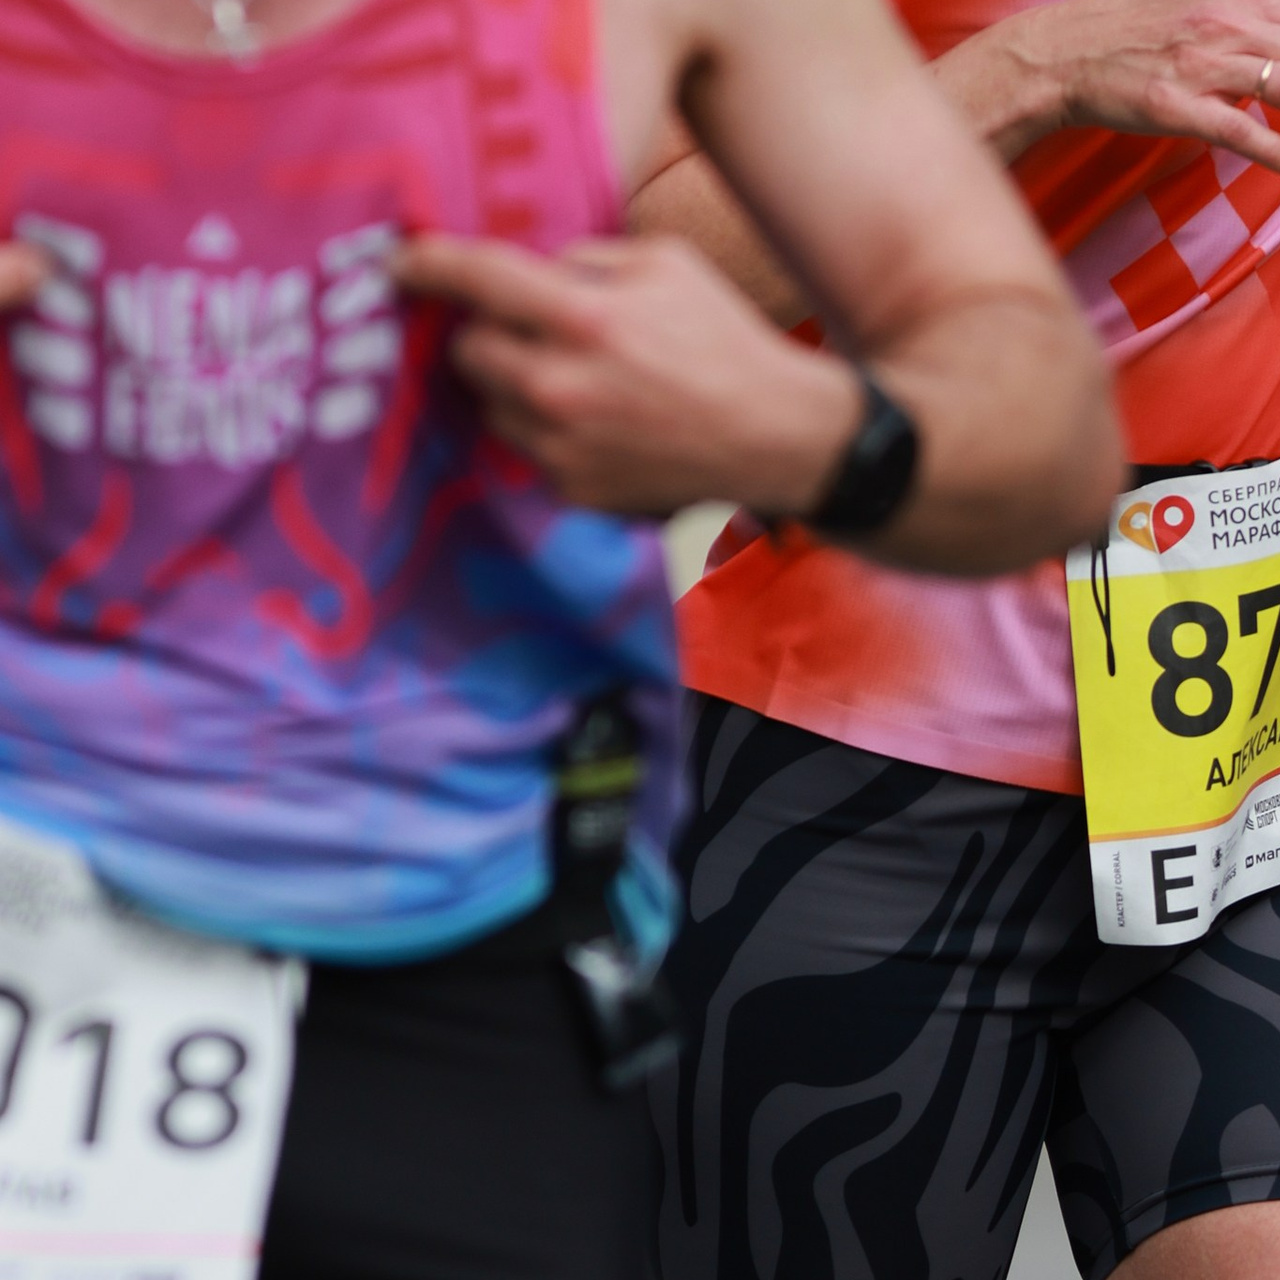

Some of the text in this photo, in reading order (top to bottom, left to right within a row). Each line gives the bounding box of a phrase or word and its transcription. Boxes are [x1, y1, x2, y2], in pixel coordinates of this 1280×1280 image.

[1256, 810, 1279, 829] СПОРТ
[1112, 851, 1122, 885] CORRAL
[1150, 845, 1199, 926] E
[1115, 891, 1125, 928] КЛАСТЕР
